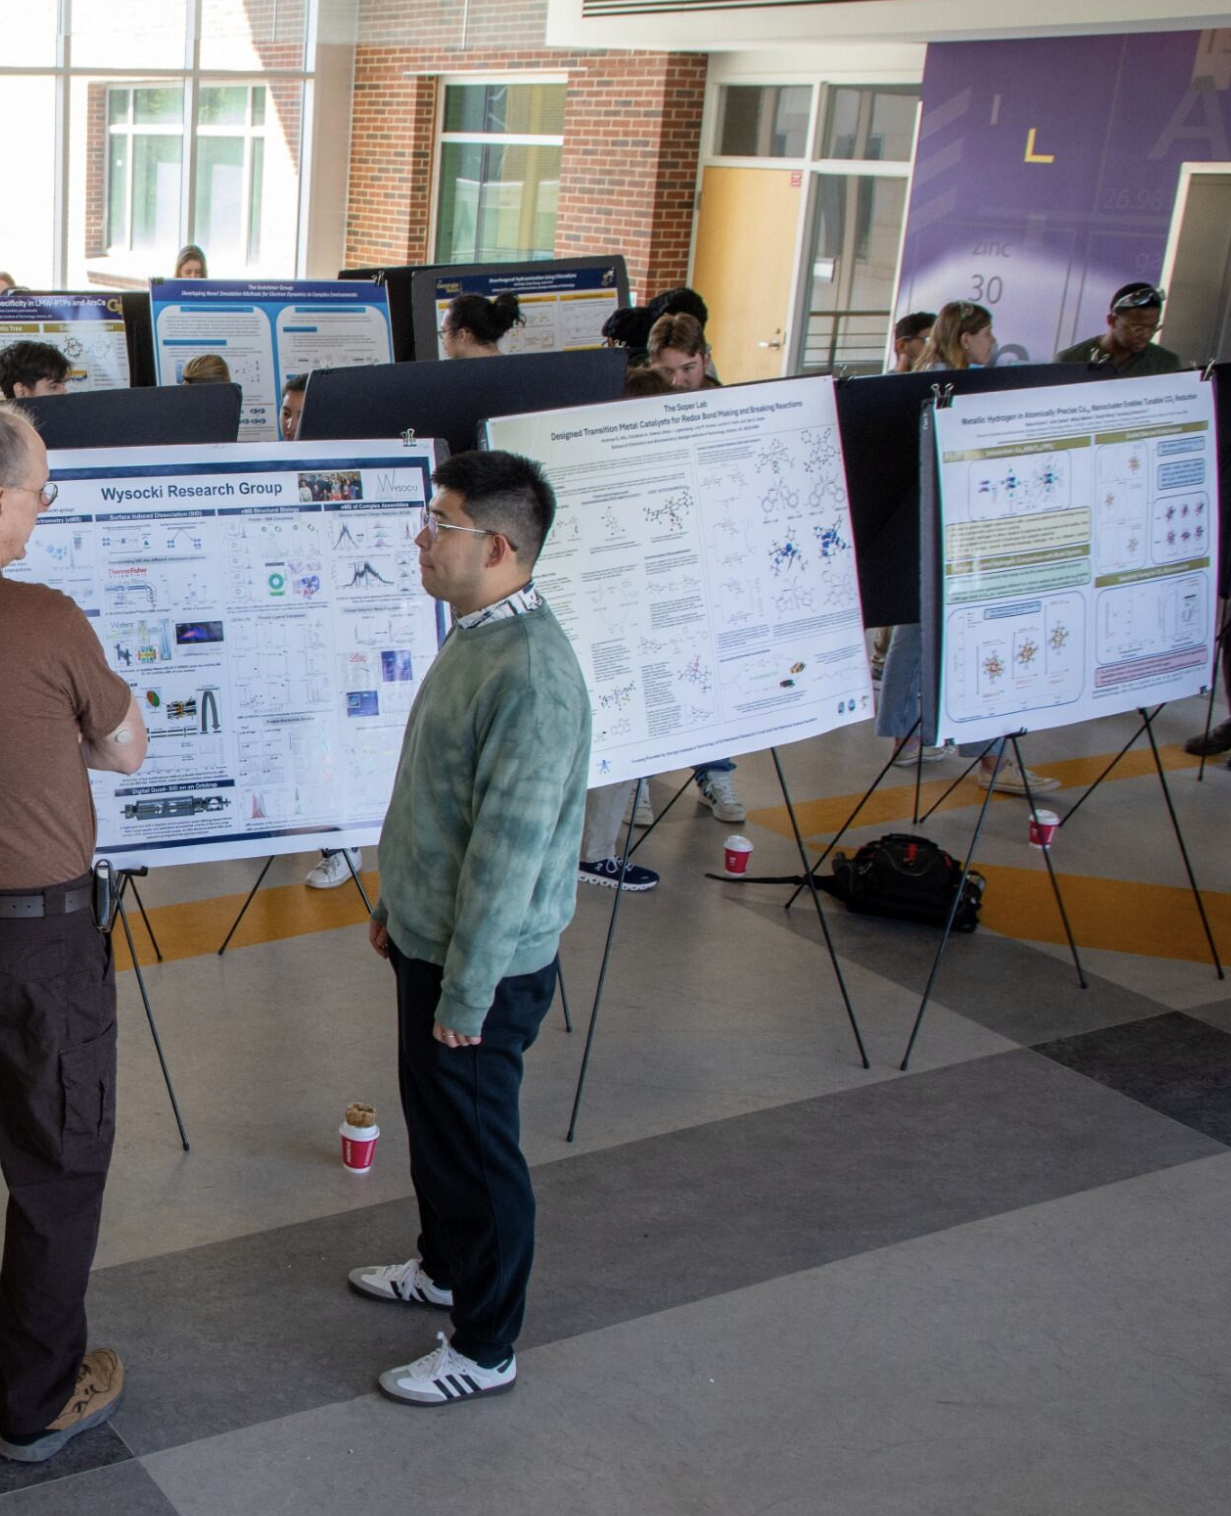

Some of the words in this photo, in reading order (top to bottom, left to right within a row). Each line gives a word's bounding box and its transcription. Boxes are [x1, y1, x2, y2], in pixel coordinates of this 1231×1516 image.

[1024, 128, 1054, 163] L
[972, 238, 1011, 258] zinc
[968, 274, 1004, 305] 30
[664, 404, 676, 413] The
[676, 403, 695, 412] Soper
[696, 401, 707, 409] Lab
[987, 414, 1016, 424] Hydrogen
[1025, 409, 1055, 418] Atomically
[1144, 398, 1163, 406] Tunable
[551, 429, 582, 441] Designed
[583, 424, 618, 436] Transition
[619, 421, 638, 430] Metal
[639, 417, 670, 428] Catalysts
[671, 415, 681, 424] for
[682, 413, 701, 422] Redox
[702, 412, 717, 420] Bond
[718, 408, 738, 418] Making
[750, 404, 775, 413] Breaking
[775, 401, 803, 409] Reactions
[101, 486, 163, 503] Wysocki
[168, 482, 234, 497] Research
[239, 482, 282, 496] Group
[132, 786, 150, 795] Digital
